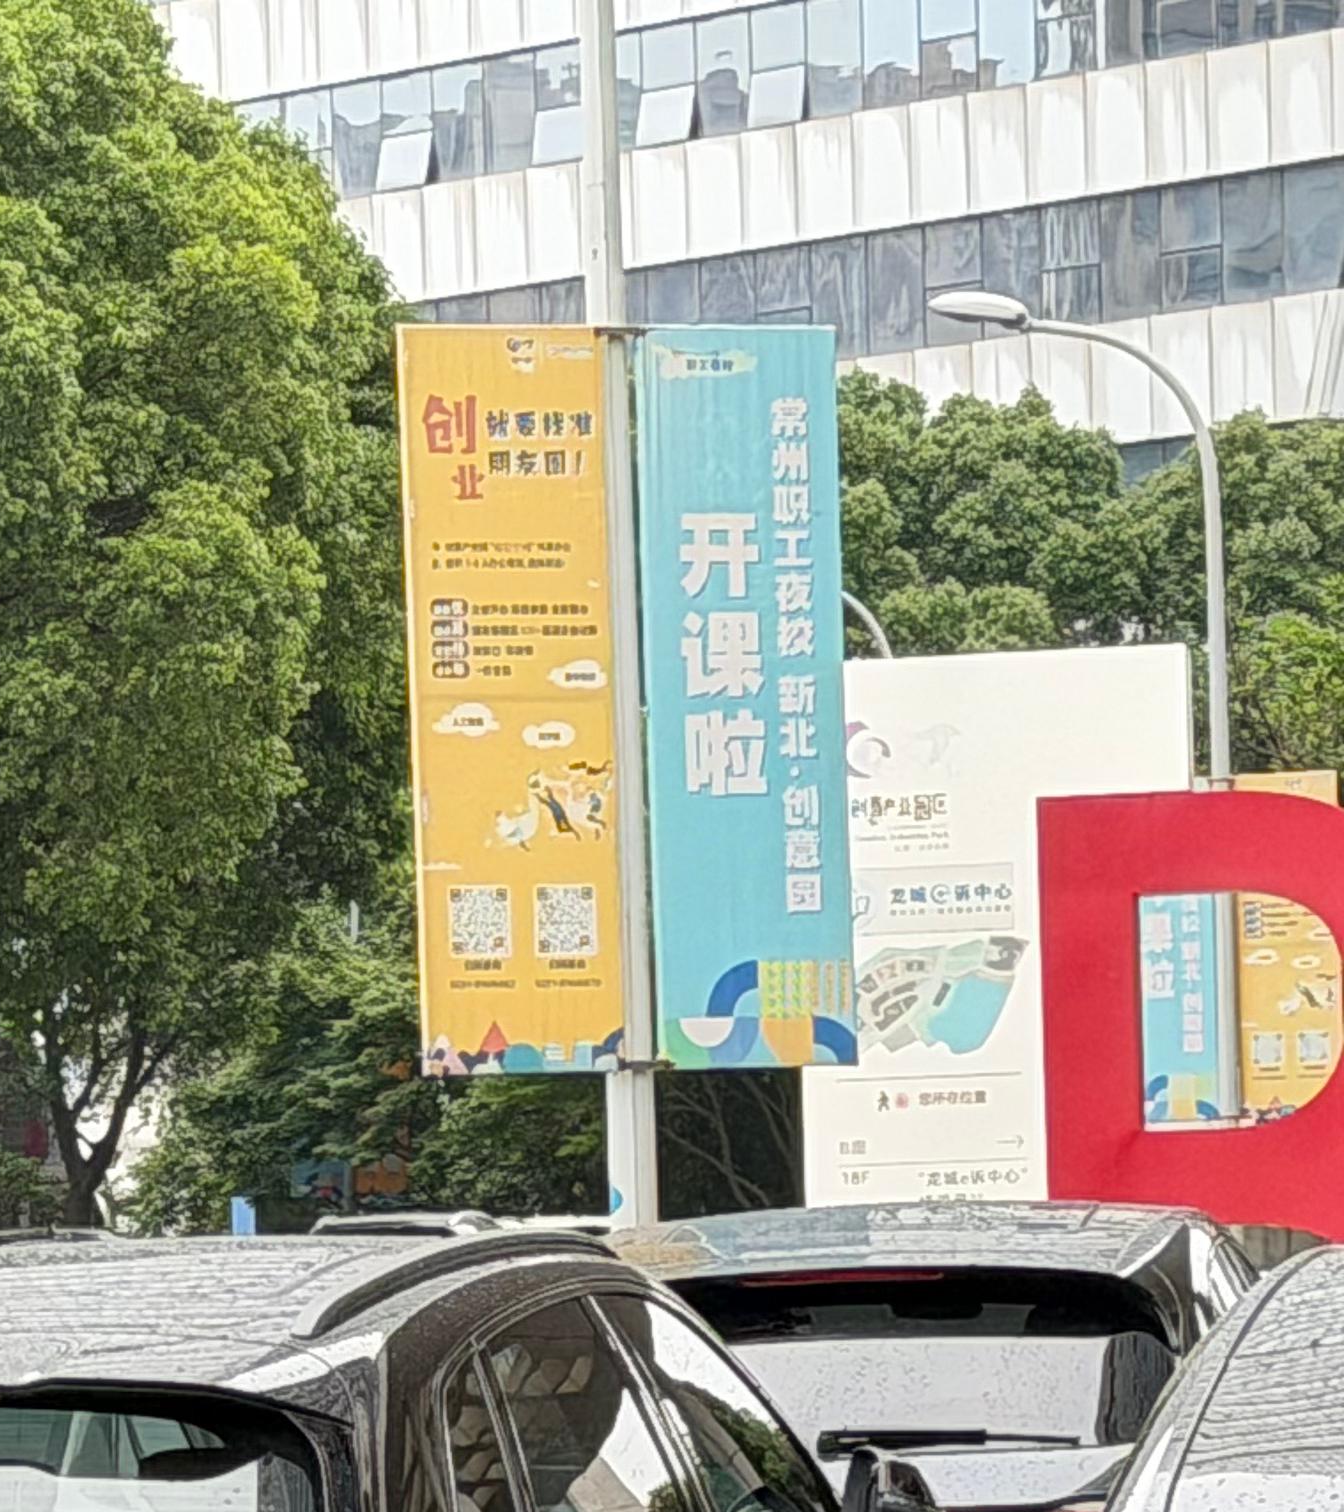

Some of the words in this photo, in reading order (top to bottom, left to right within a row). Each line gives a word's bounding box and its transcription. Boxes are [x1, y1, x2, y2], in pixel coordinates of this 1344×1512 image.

[485, 409, 593, 437] 就要找准
[770, 397, 815, 658] 常州职工夜校
[679, 513, 768, 796] 开课啦
[777, 675, 823, 914] 新北·创意园
[841, 1170, 871, 1186] 18F
